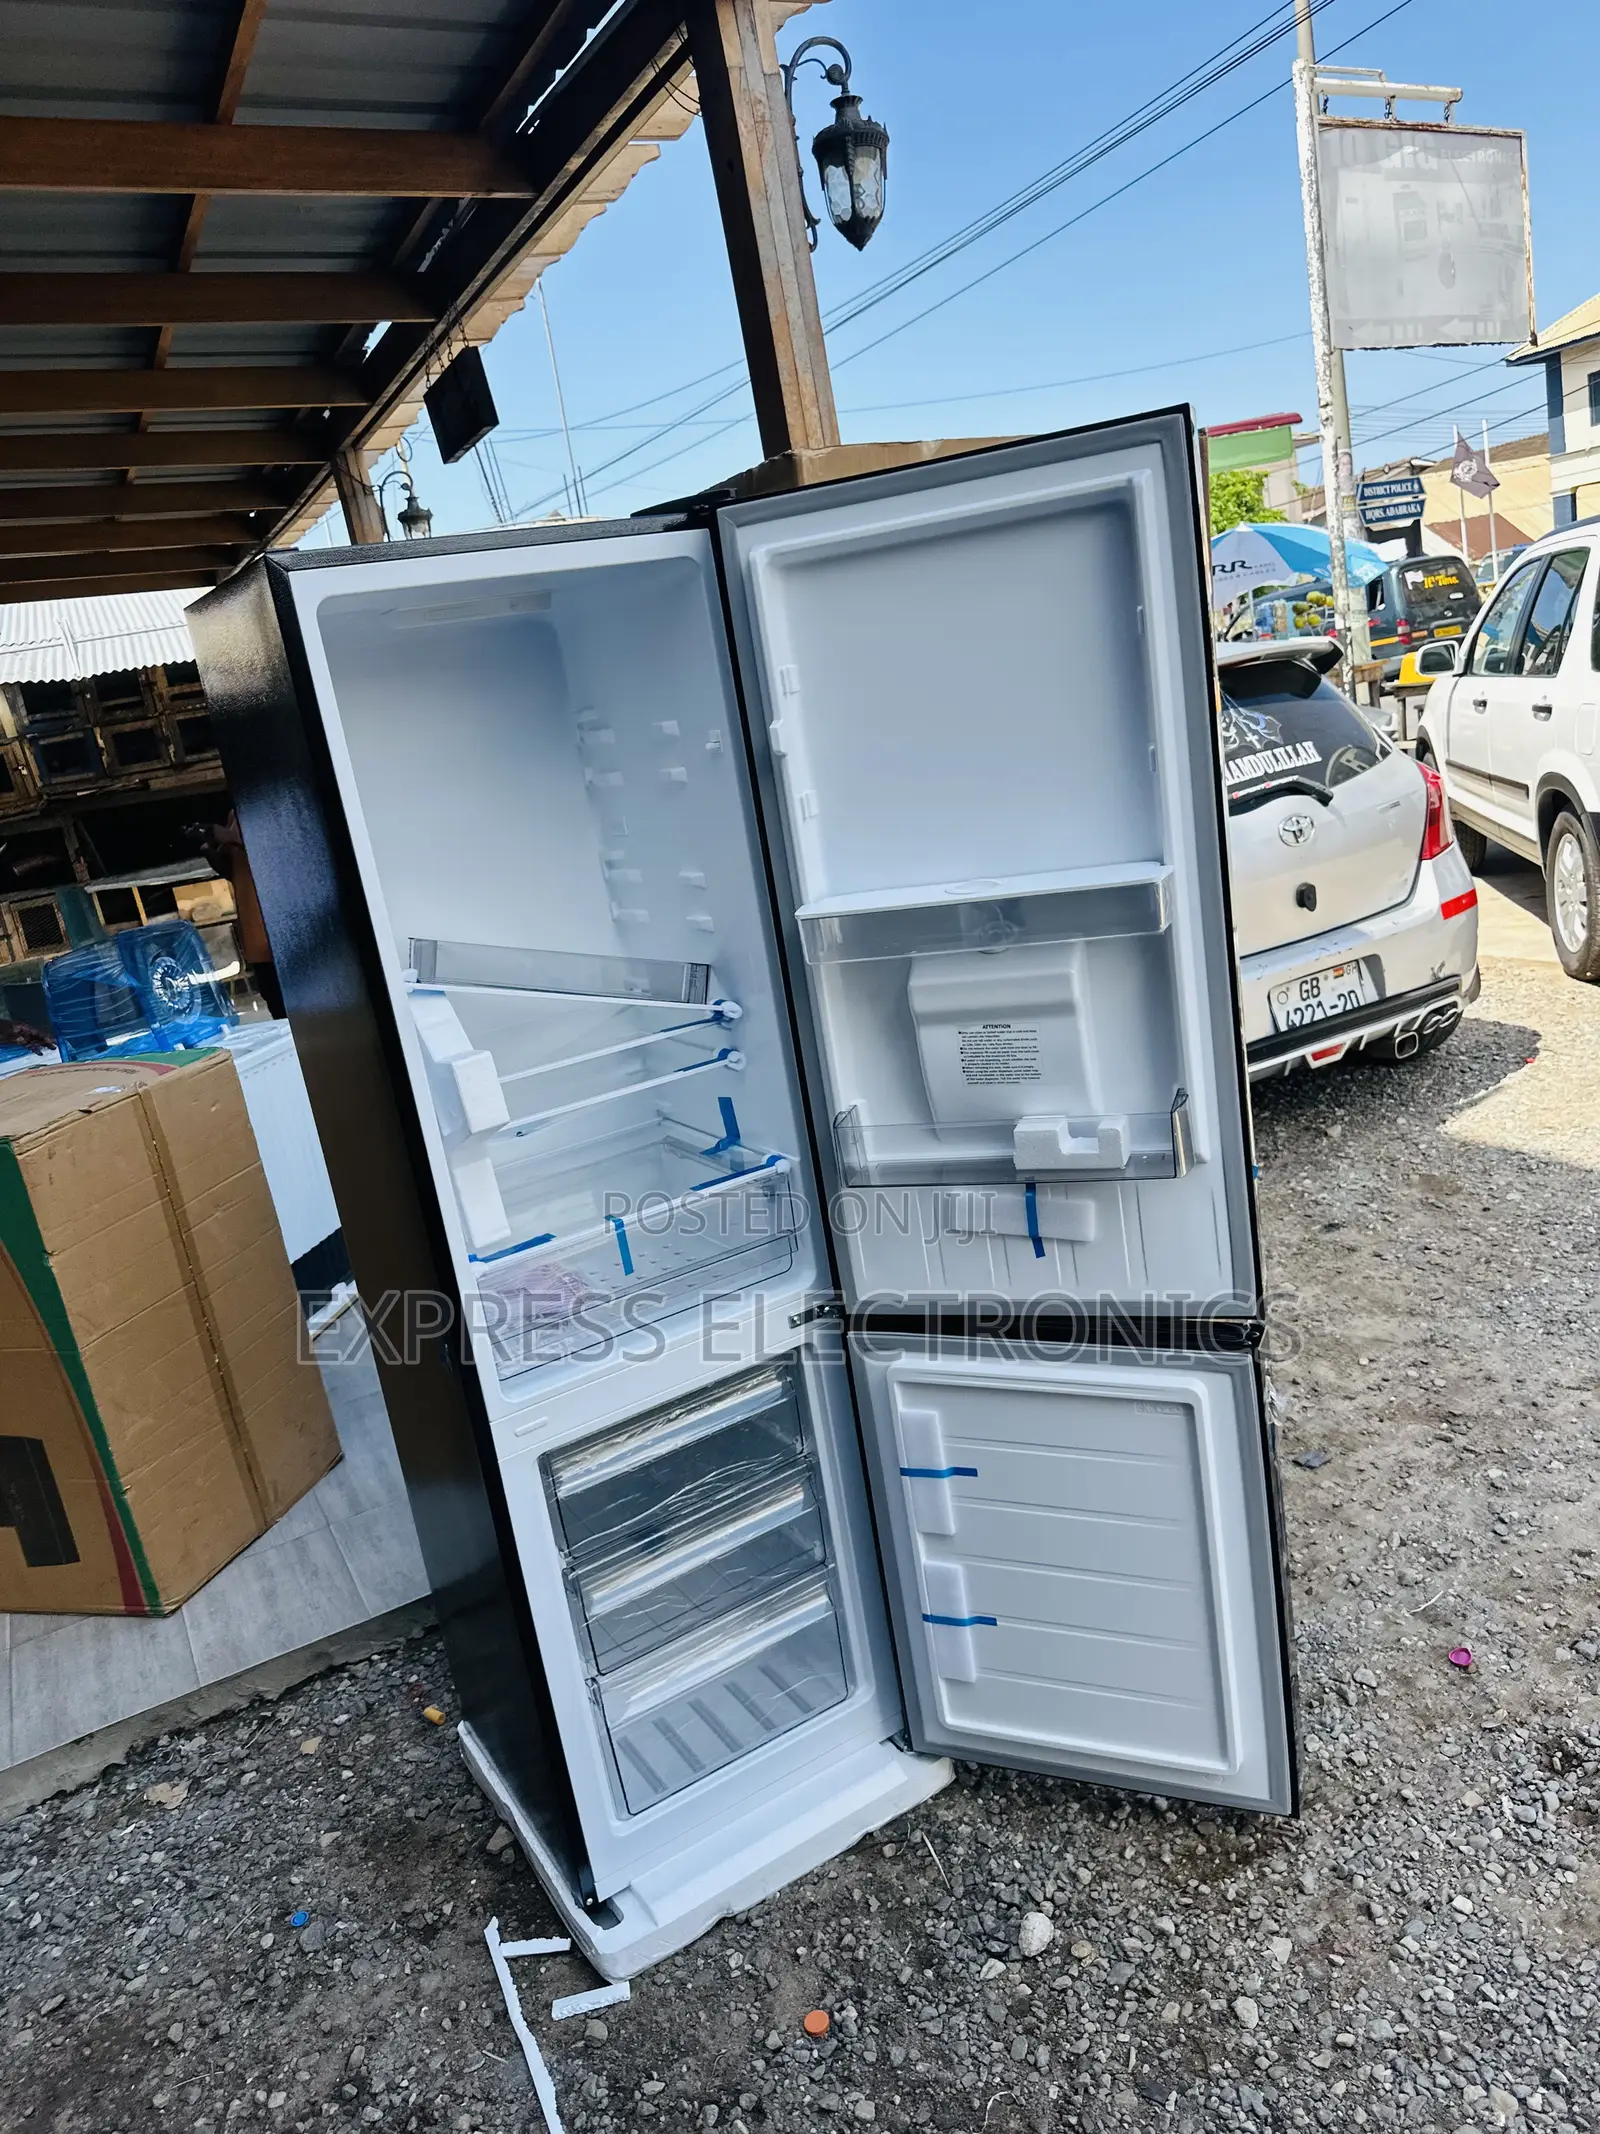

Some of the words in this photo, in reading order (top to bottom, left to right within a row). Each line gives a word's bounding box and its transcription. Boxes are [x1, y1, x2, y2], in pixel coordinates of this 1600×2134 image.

[1363, 484, 1390, 497] DISTRICT
[1391, 482, 1413, 495] POLICE
[1299, 976, 1321, 1002] GB
[1345, 964, 1357, 976] GH
